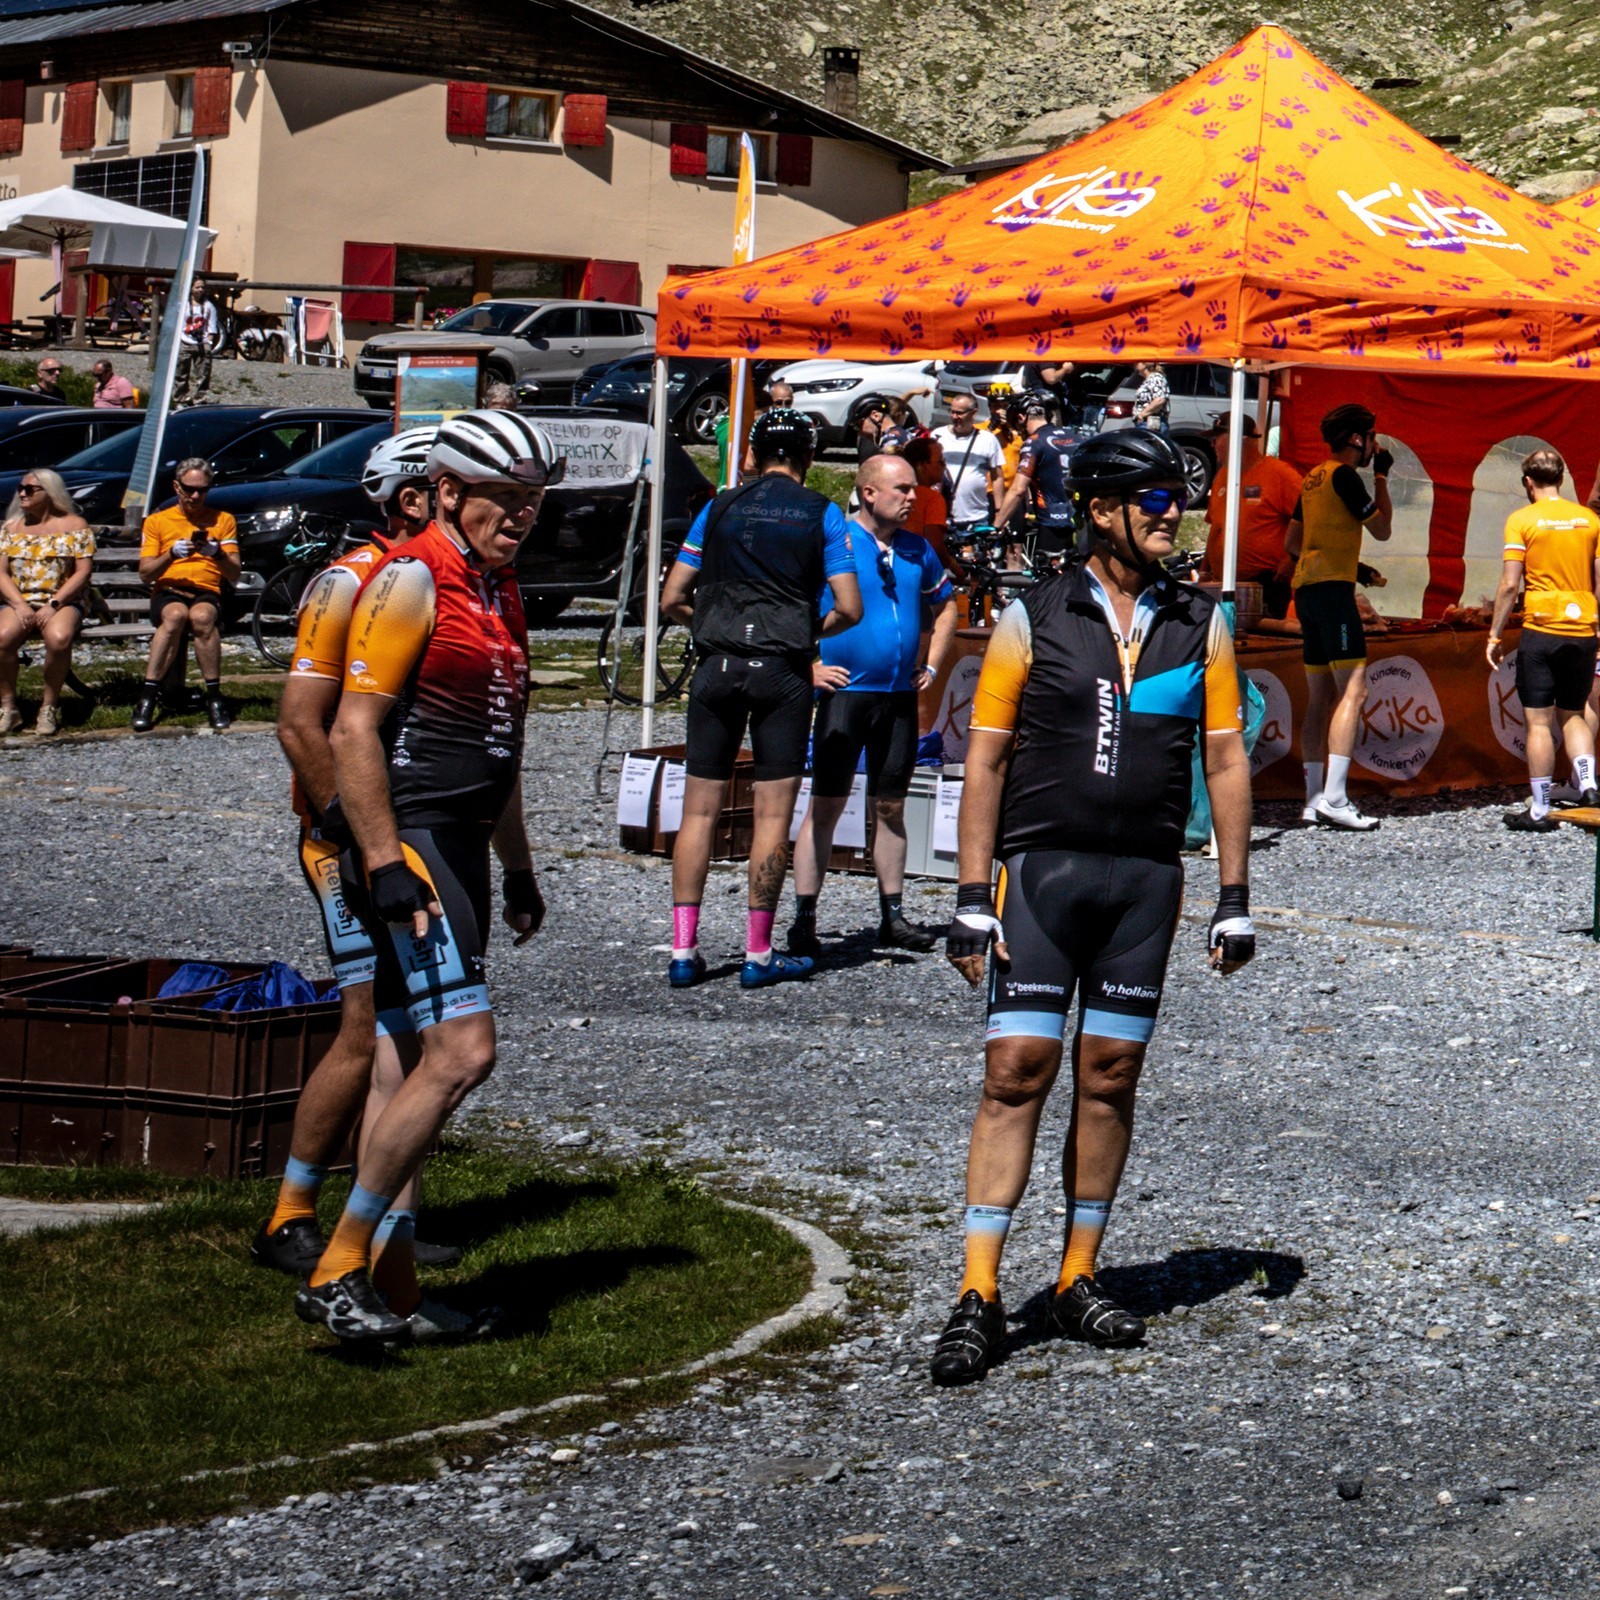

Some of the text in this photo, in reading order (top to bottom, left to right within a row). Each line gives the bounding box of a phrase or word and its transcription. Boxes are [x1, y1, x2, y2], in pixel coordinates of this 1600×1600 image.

[992, 166, 1156, 217] Kika
[1337, 182, 1509, 237] Kika
[993, 214, 1117, 235] kinderenkankervrij
[1369, 665, 1412, 685] Kinderen
[1358, 696, 1438, 746] KiKa
[1110, 712, 1122, 778] RACING TEAM
[1368, 748, 1428, 771] Kankervrij
[1017, 983, 1064, 996] beekenkamp
[1102, 981, 1116, 996] kp
[1117, 983, 1158, 999] holland
